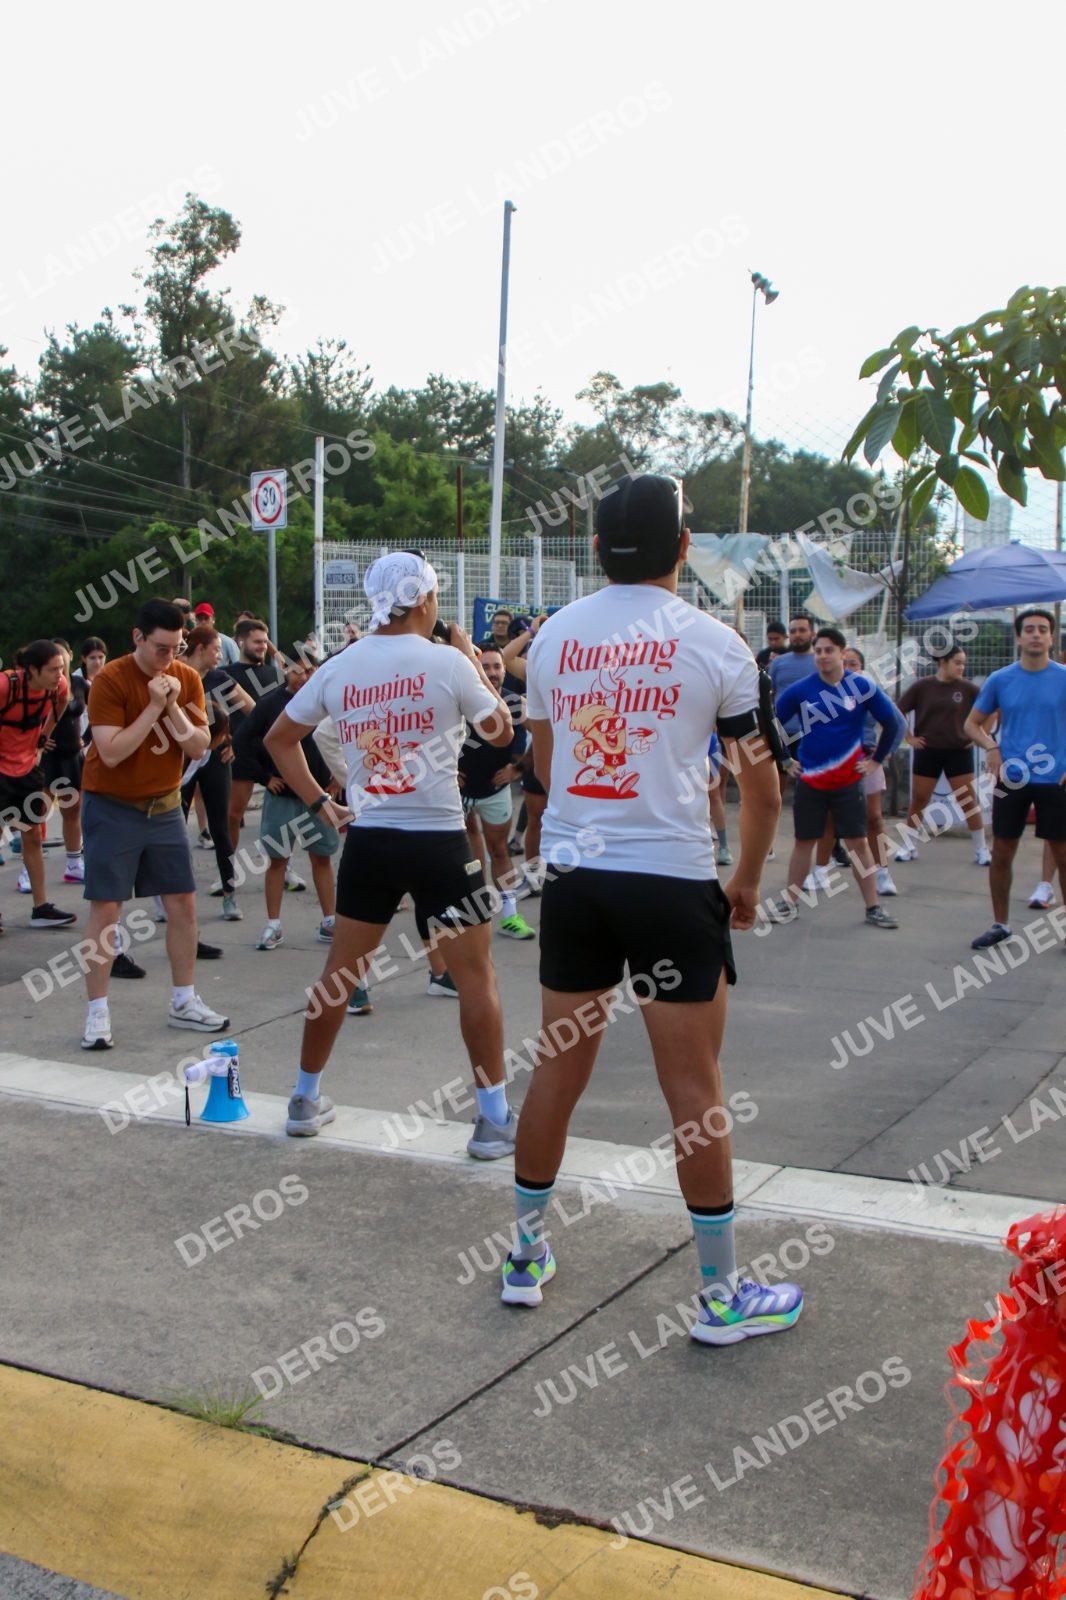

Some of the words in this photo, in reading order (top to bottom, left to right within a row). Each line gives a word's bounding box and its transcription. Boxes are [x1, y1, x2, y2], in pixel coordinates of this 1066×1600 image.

[262, 486, 276, 507] 30
[484, 603, 530, 615] CURSOS
[533, 607, 548, 615] DE
[559, 633, 680, 675] Running
[343, 672, 426, 712] Running
[551, 679, 682, 724] Brunhing
[339, 707, 434, 745] Brunhing
